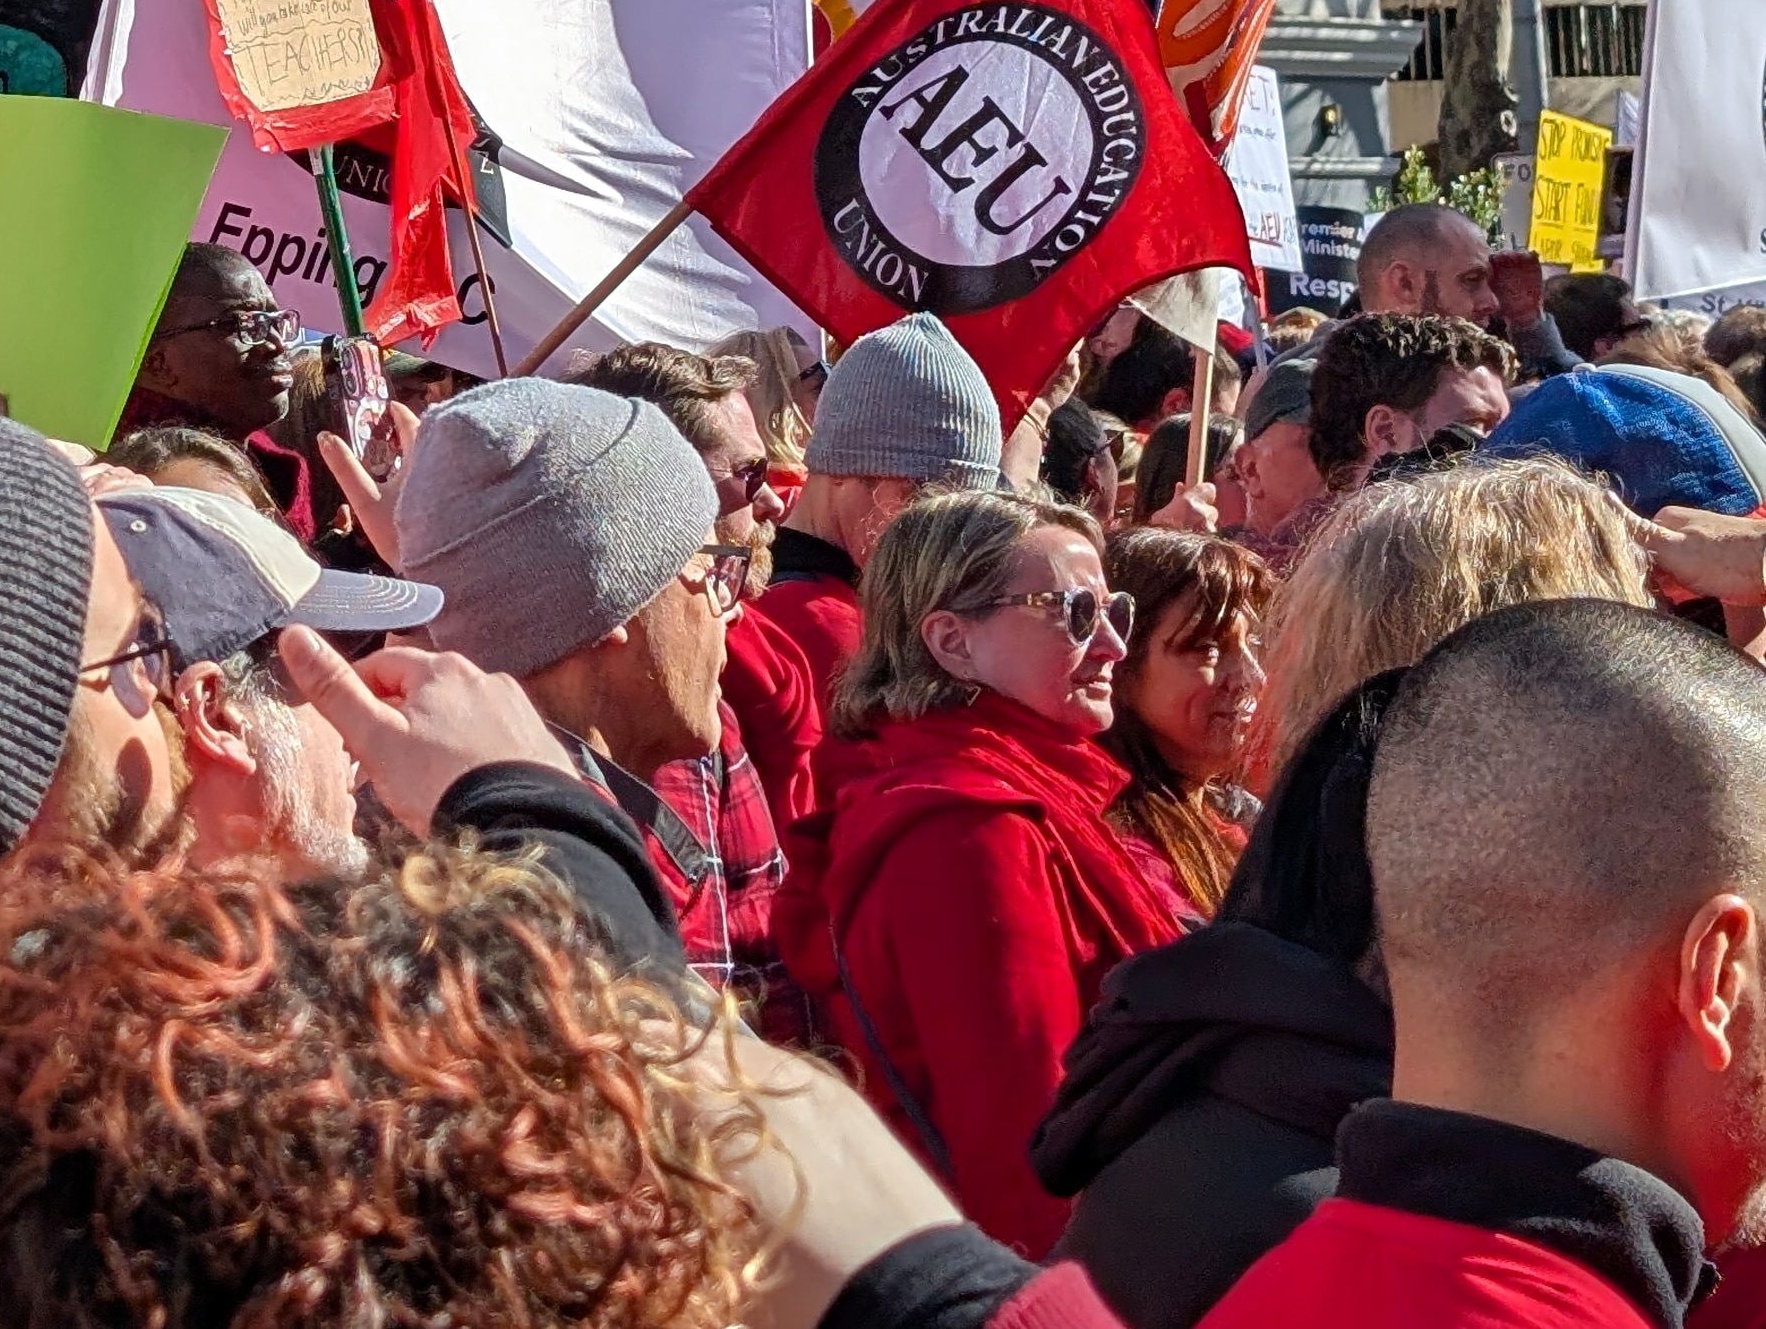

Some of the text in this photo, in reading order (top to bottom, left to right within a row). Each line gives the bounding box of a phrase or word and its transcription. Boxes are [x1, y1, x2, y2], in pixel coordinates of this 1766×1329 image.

[850, 6, 1100, 108] AUSTRALIAN
[878, 64, 1072, 236] AEU
[1030, 60, 1137, 280] EDUCATION
[833, 198, 929, 303] UNION
